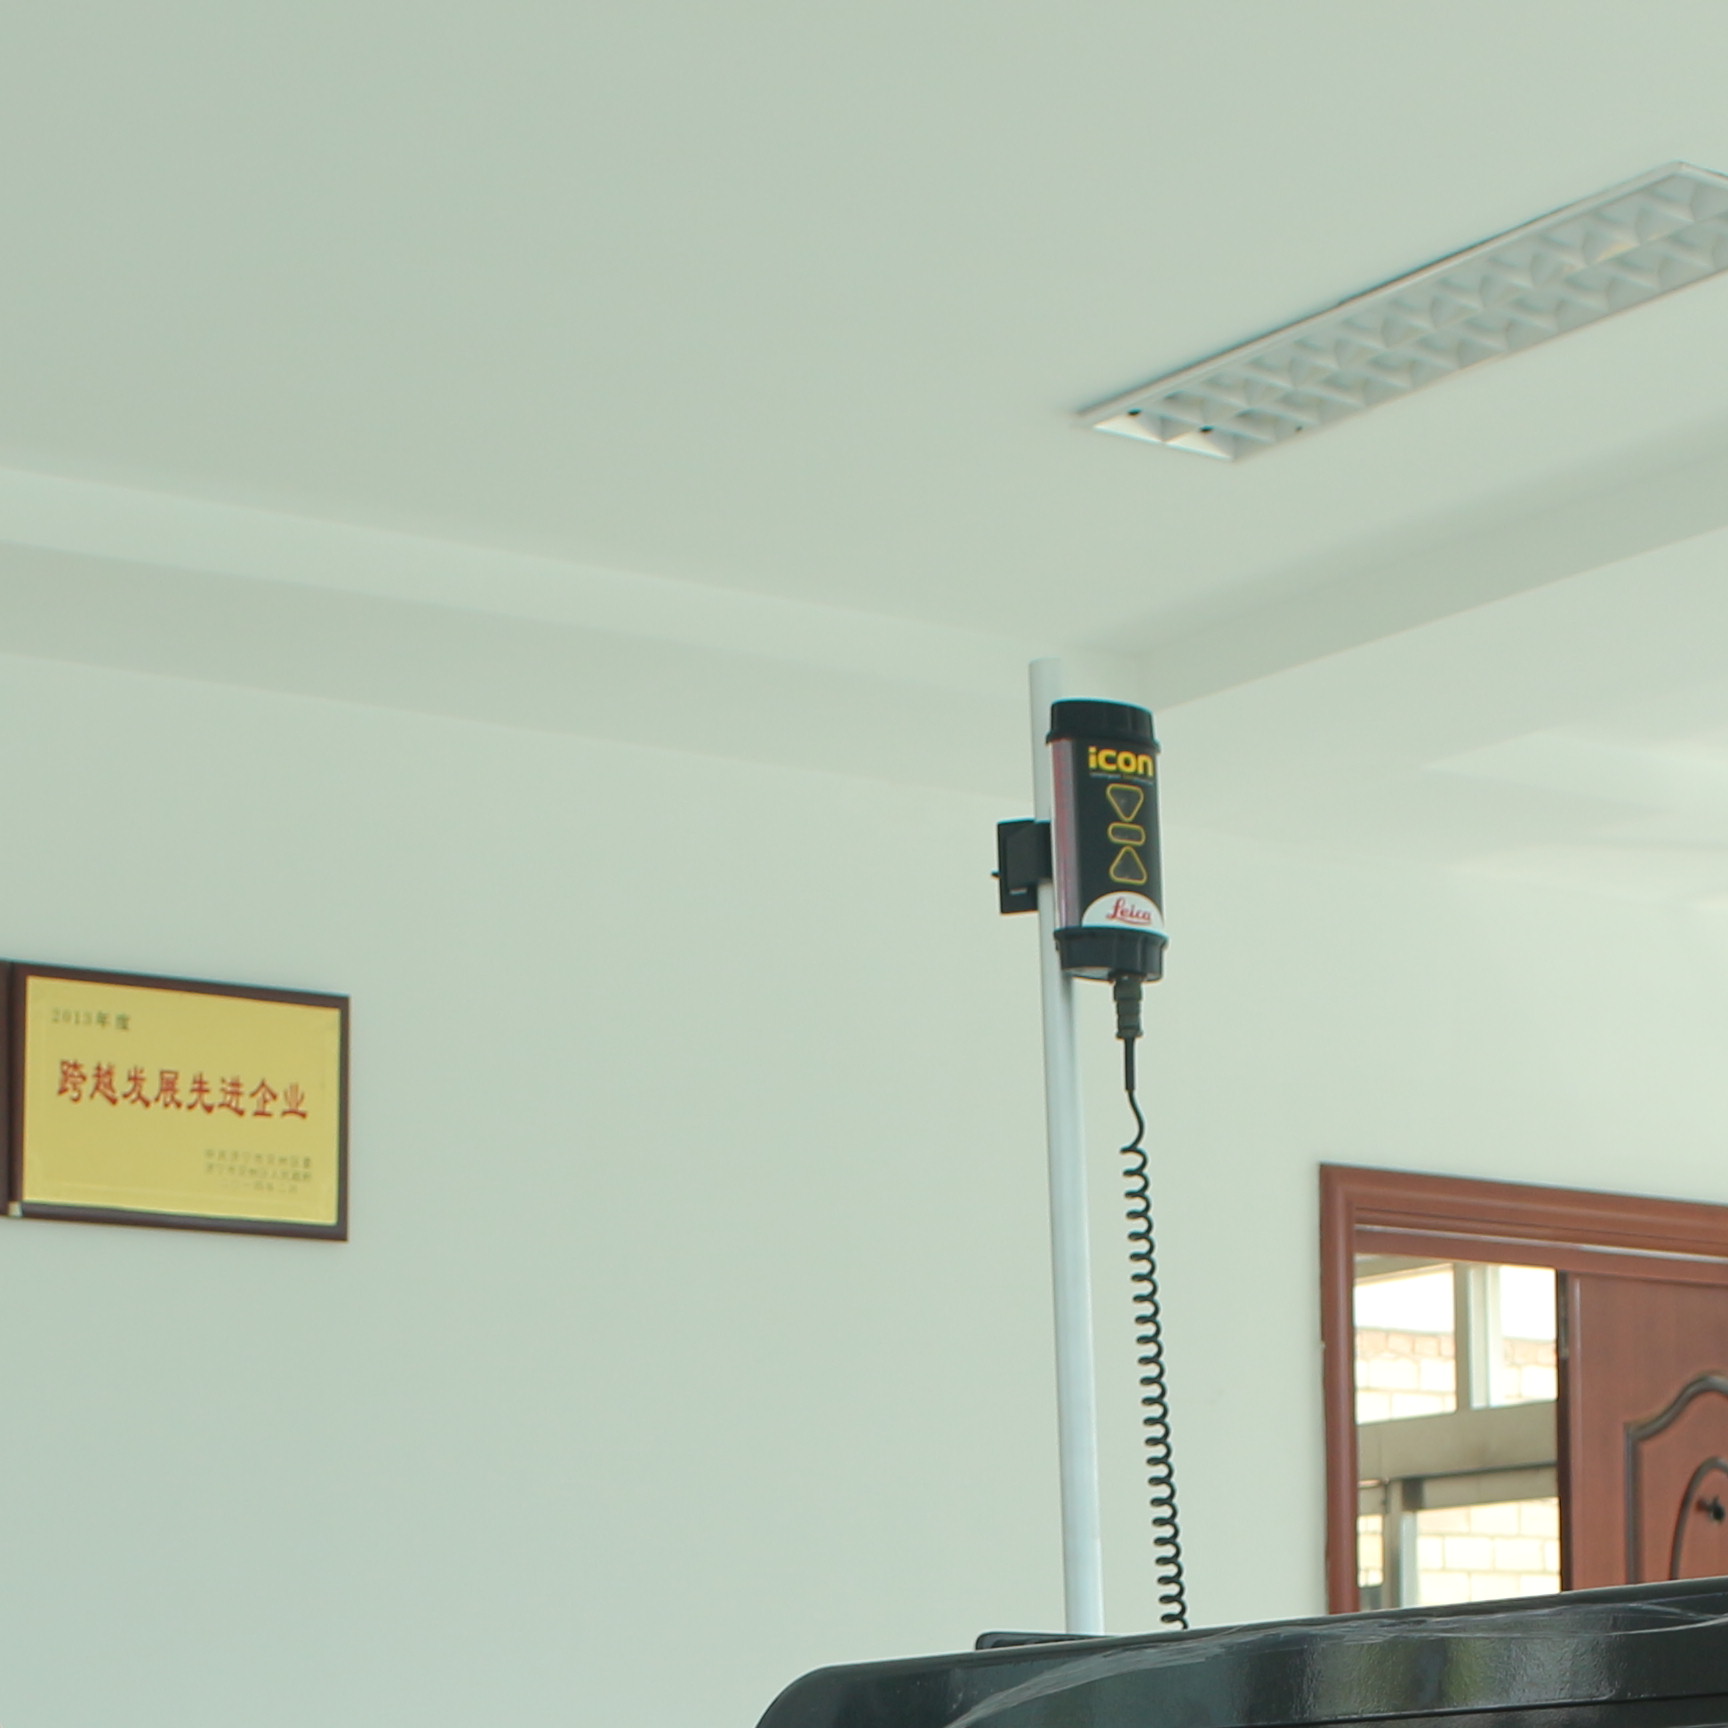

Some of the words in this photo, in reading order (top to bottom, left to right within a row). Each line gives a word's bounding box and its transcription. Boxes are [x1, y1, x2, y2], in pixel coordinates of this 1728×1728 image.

[1106, 898, 1152, 926] Leica
[57, 1059, 308, 1119] 跨越发展先进企业
